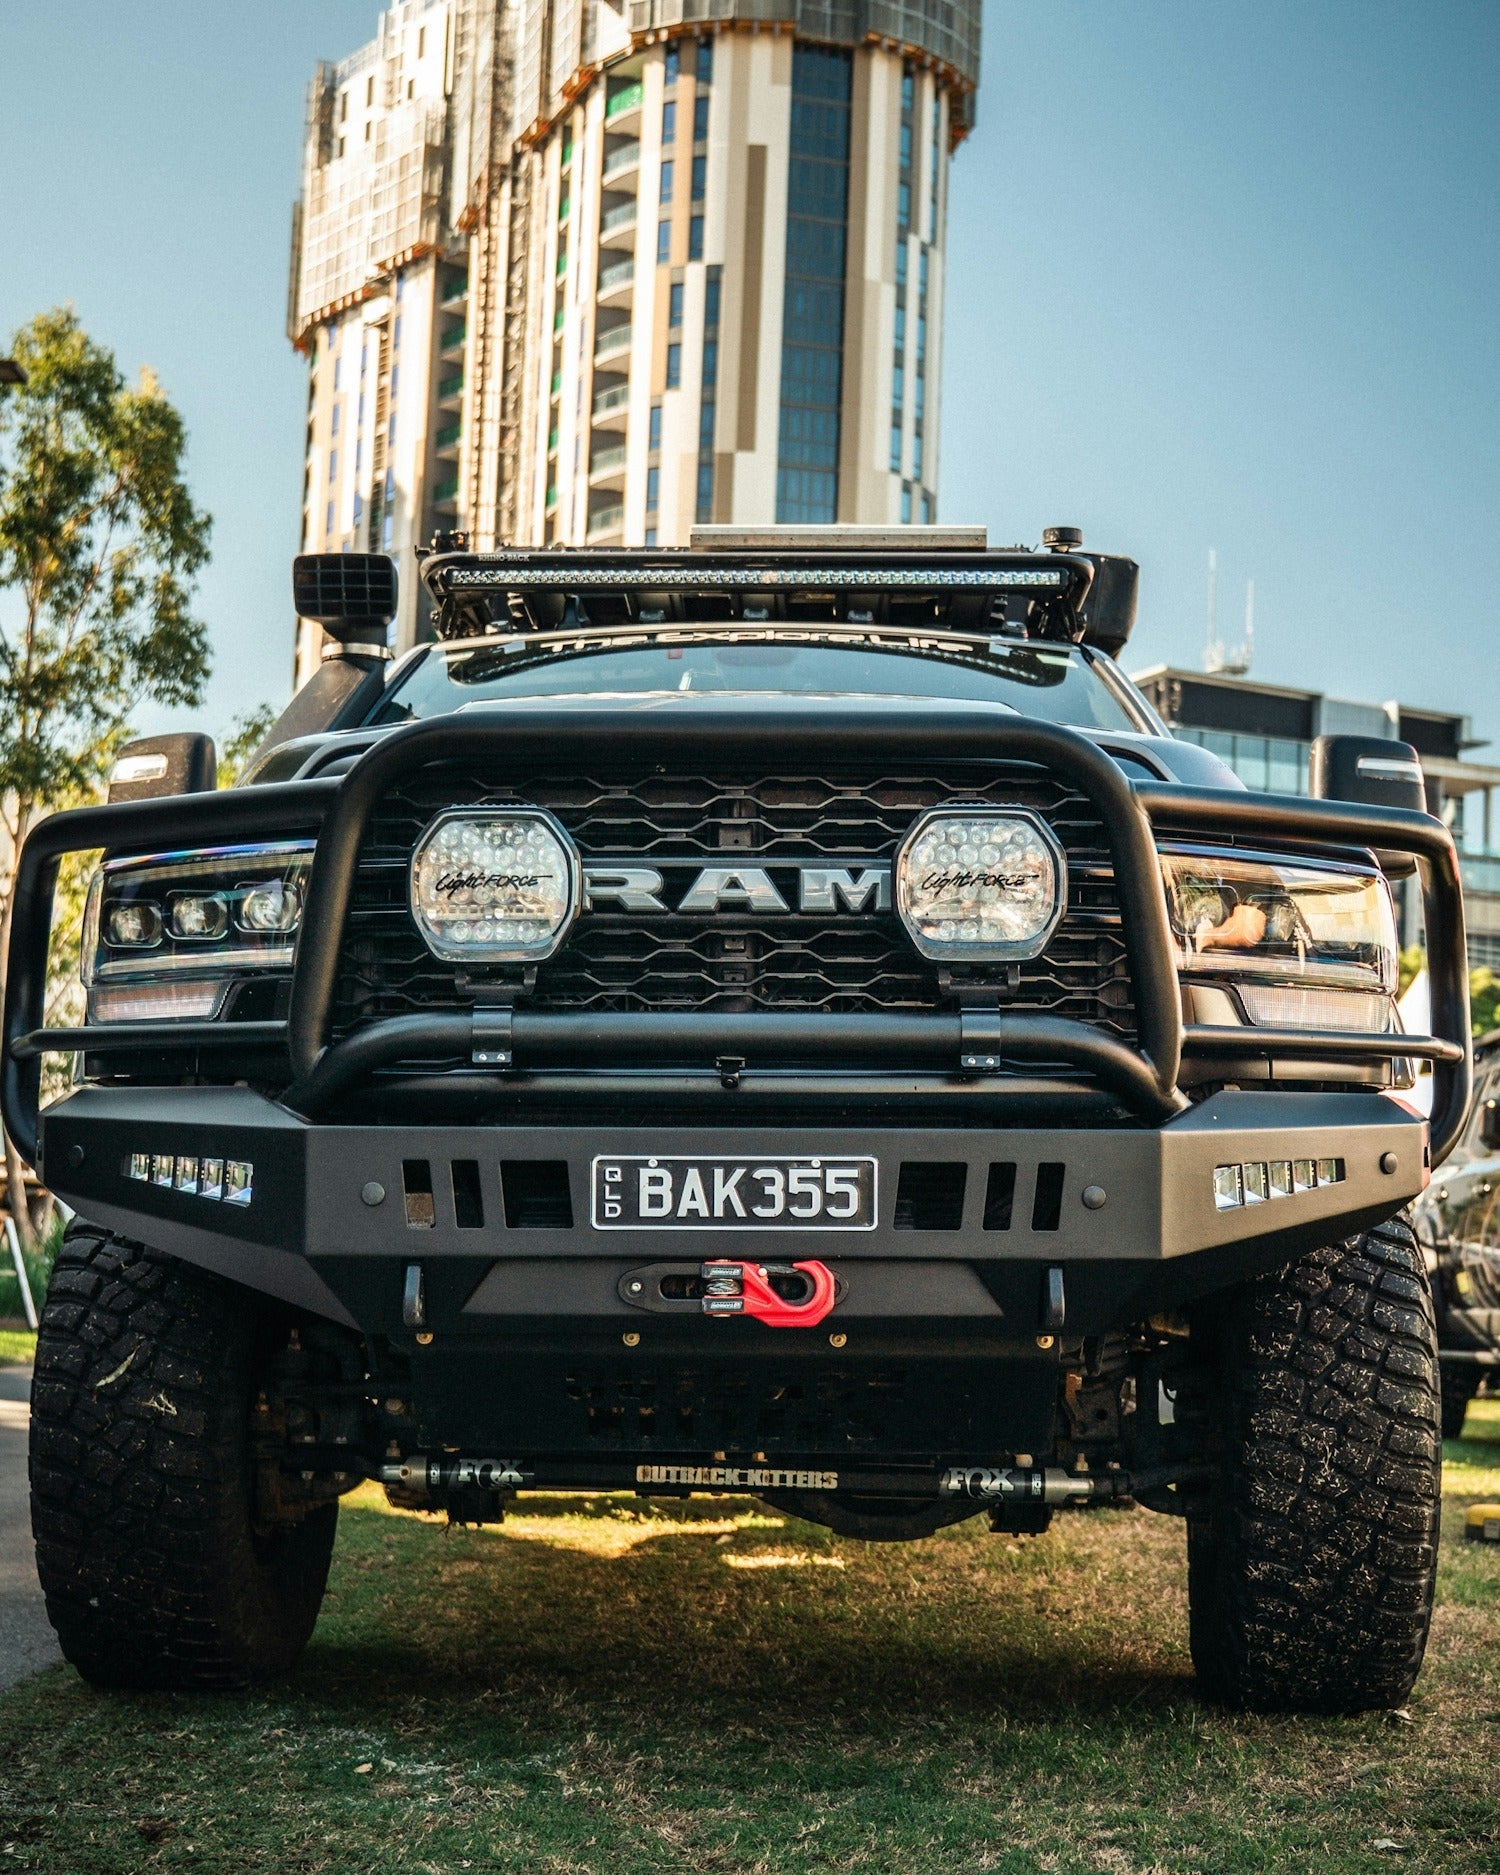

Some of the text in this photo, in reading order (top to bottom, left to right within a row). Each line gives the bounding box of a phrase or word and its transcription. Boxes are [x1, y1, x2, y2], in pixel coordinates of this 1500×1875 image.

[478, 554, 530, 562] RHINO-RACK
[541, 634, 649, 652] The
[582, 867, 892, 911] RAM
[604, 1167, 623, 1218] QLD
[638, 1167, 860, 1218] BAK355
[458, 1458, 524, 1488] FOX
[636, 1465, 838, 1489] OUTBACK KITTERS
[948, 1467, 1014, 1498] FOX
